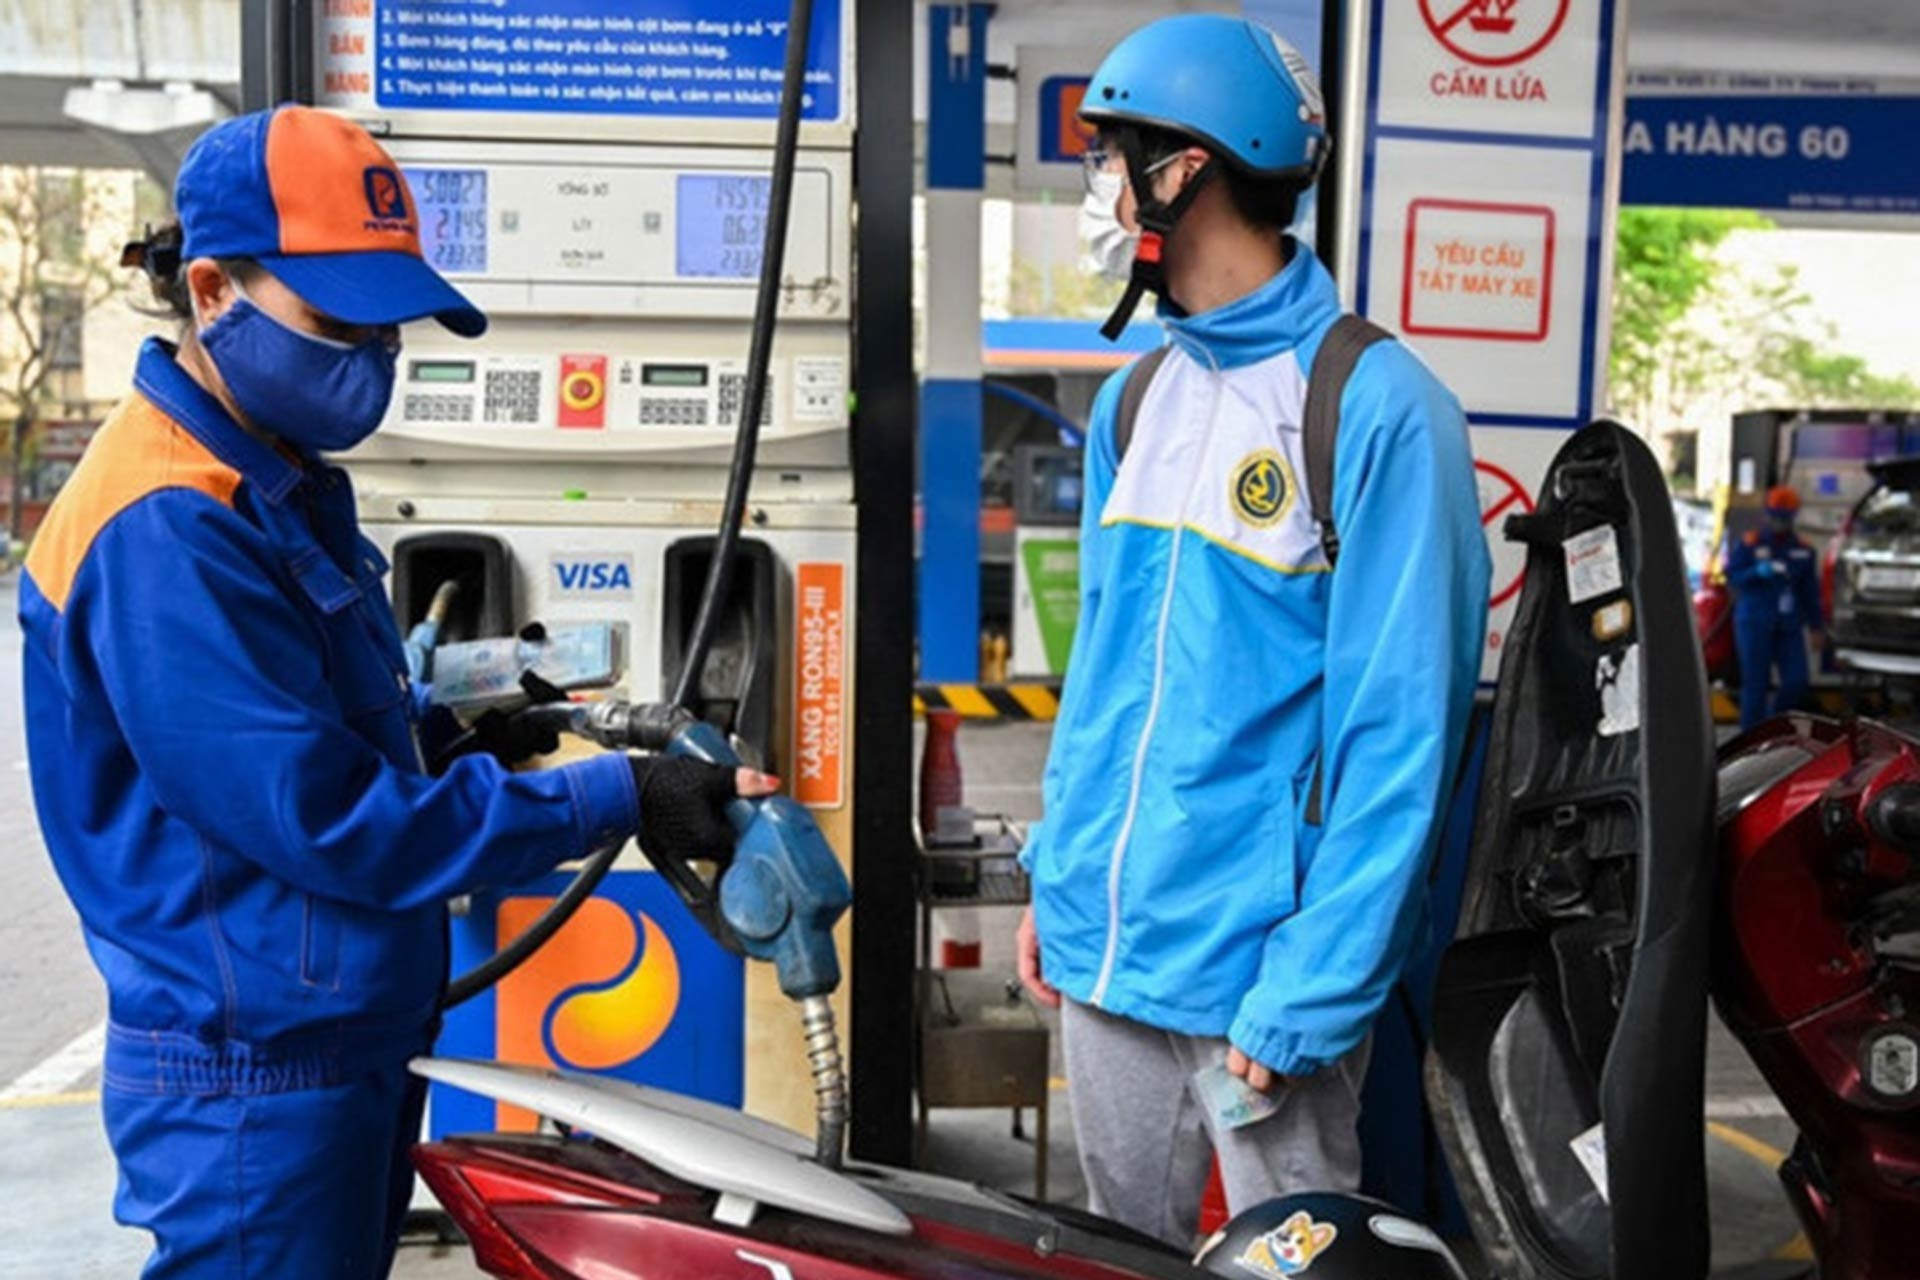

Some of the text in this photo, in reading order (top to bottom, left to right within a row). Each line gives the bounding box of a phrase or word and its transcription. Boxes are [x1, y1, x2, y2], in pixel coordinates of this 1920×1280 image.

[427, 11, 466, 26] khách
[470, 12, 505, 30] hàng
[434, 36, 467, 52] hàng
[649, 43, 688, 56] khách
[427, 58, 466, 73] khách
[470, 59, 505, 77] hàng
[735, 90, 774, 105] khách
[1429, 66, 1547, 102] CẤM LỬA
[1665, 114, 1787, 159] HÀNG
[1799, 126, 1850, 160] 60
[1434, 240, 1476, 267] YÊU
[1461, 271, 1506, 295] MÁY
[1509, 276, 1537, 299] XE
[555, 562, 631, 590] VISA
[801, 585, 827, 700] RON95-III
